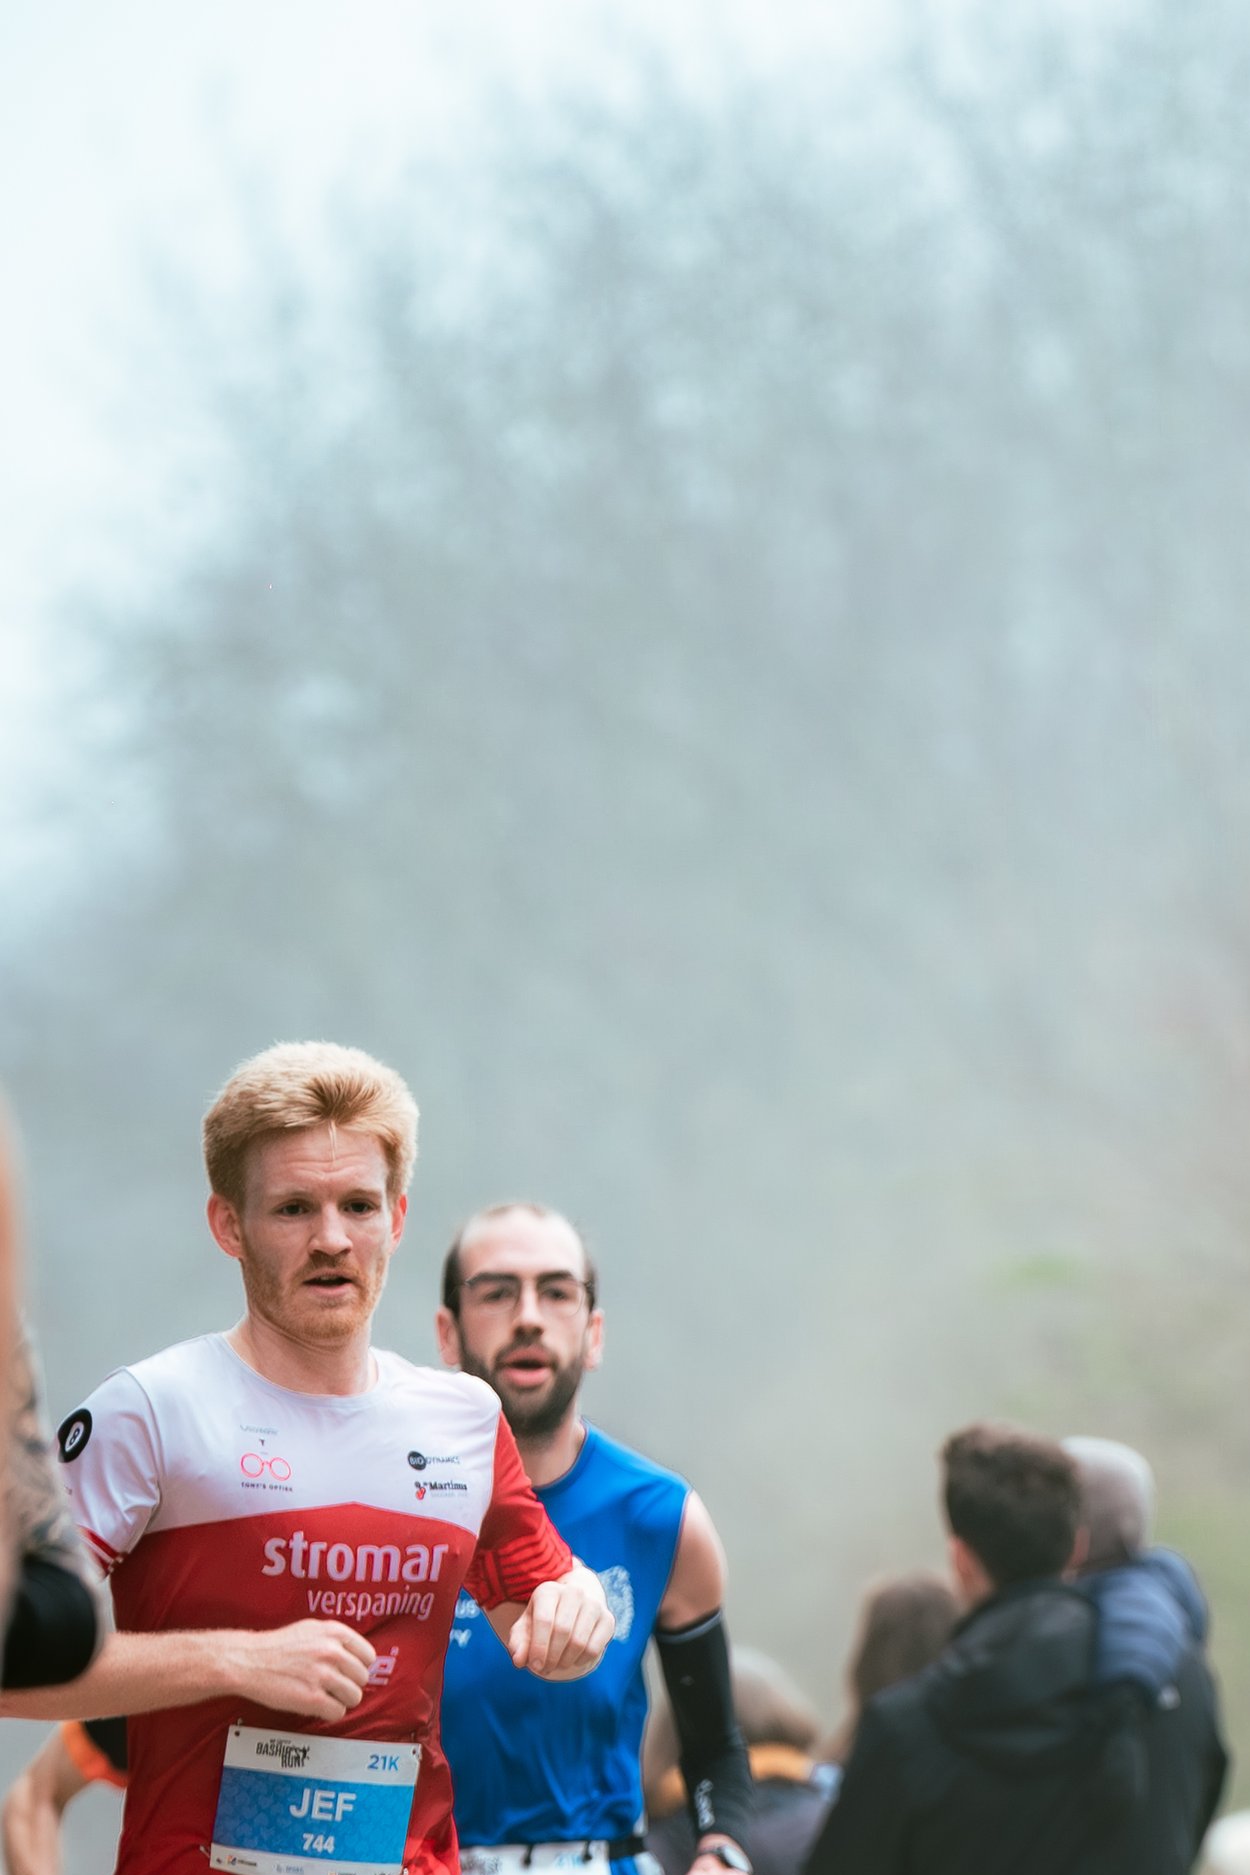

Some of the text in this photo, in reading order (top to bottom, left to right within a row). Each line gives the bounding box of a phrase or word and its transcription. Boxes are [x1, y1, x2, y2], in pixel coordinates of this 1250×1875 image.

[261, 1530, 449, 1582] stromar
[307, 1585, 434, 1621] verspaning
[367, 1754, 400, 1771] 21K
[289, 1788, 357, 1822] JEF
[303, 1833, 335, 1854] 744
